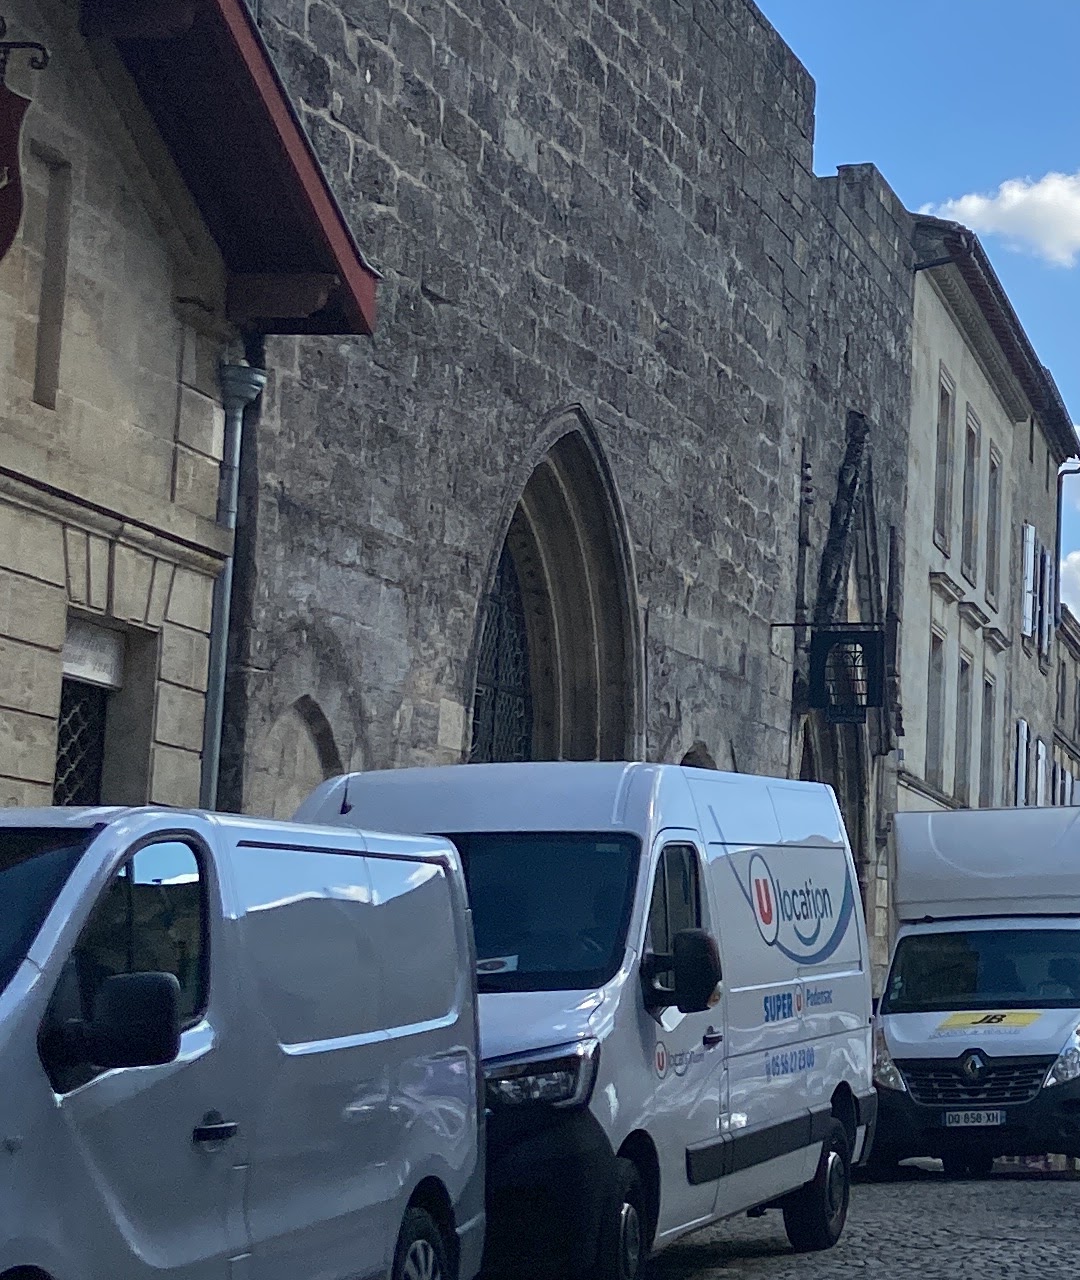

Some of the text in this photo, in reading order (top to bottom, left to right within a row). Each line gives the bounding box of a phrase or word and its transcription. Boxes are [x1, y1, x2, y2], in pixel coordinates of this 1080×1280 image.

[754, 878, 834, 925] U location
[763, 992, 793, 1022] SUPER
[970, 1014, 1007, 1024] JB
[657, 1051, 665, 1071] U
